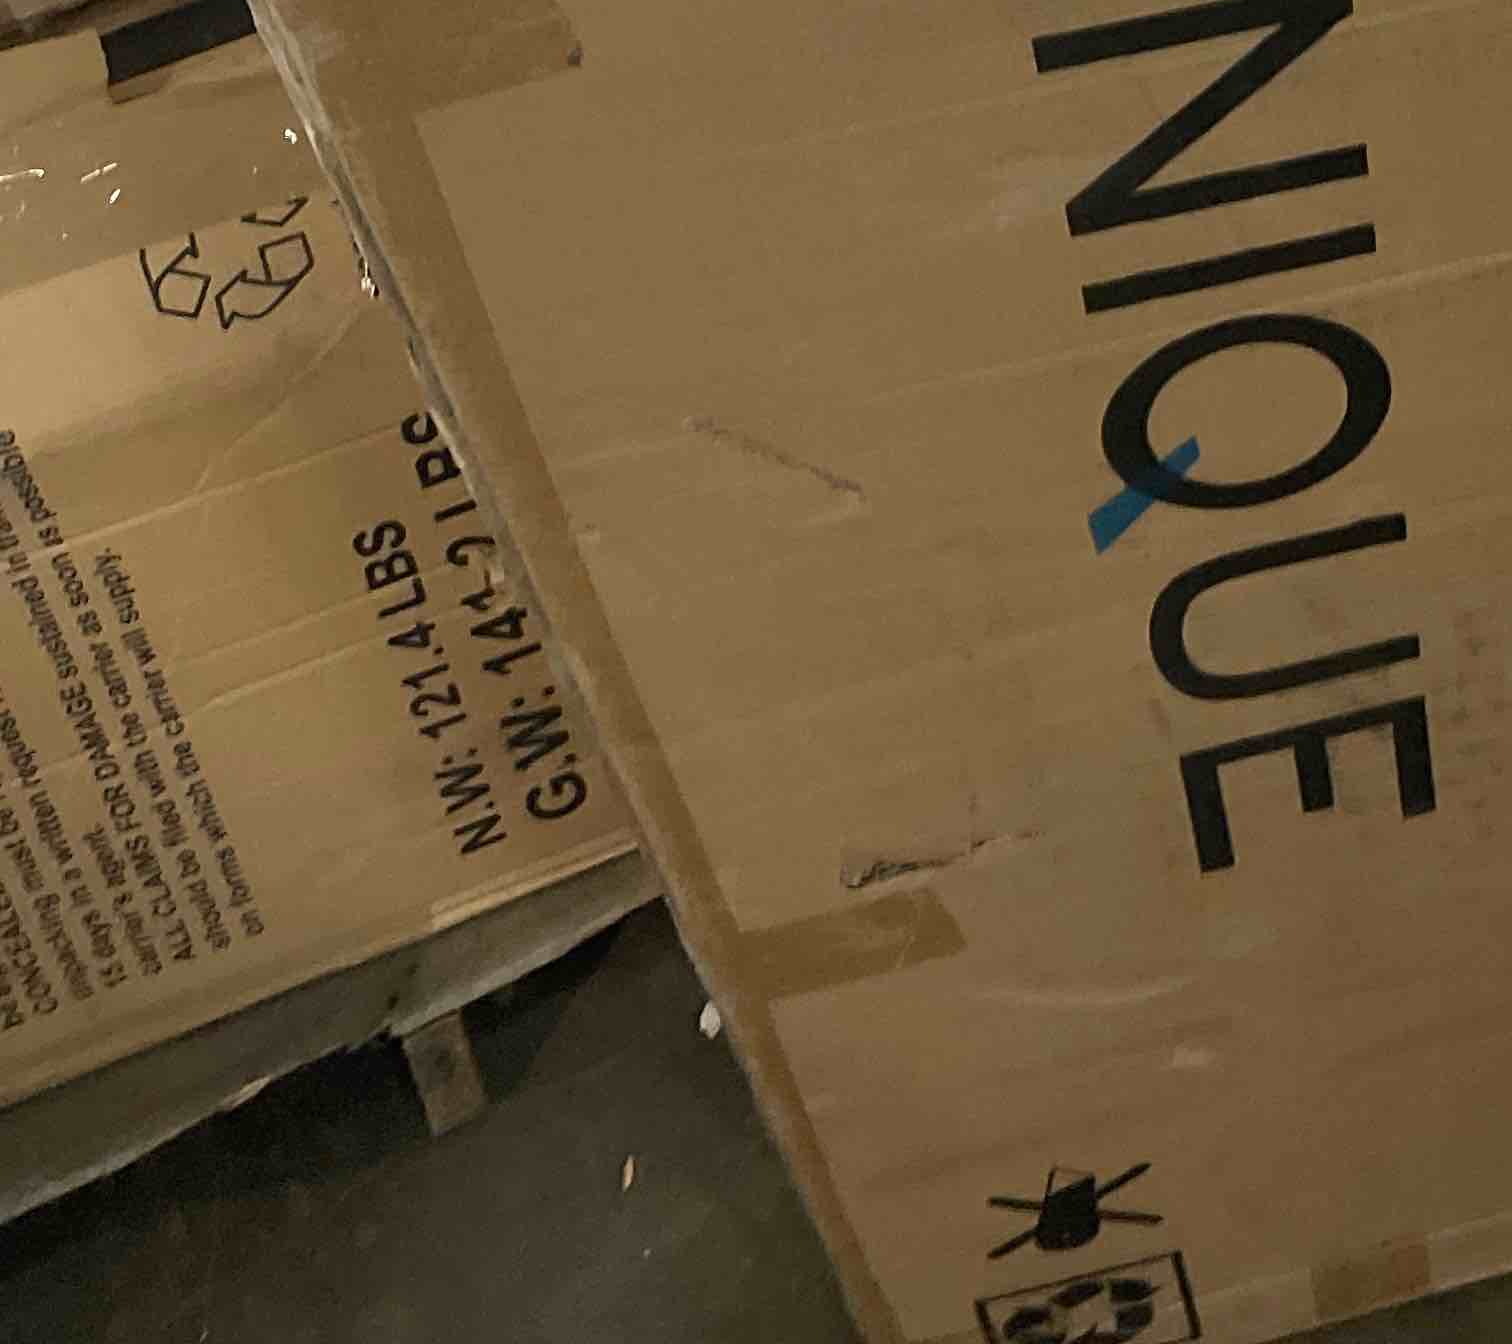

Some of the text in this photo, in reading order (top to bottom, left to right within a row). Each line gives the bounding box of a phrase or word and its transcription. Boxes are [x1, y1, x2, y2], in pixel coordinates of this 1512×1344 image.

[5, 551, 32, 575] in
[51, 551, 89, 608] soon
[94, 547, 141, 624] supply.
[11, 574, 79, 680] sustained
[77, 609, 103, 637] as
[120, 626, 157, 666] will
[90, 641, 133, 710] carrier
[143, 669, 186, 737] carrier
[352, 518, 508, 856] N.W: 121.4 LBS
[60, 682, 120, 782] DAMAGE
[120, 710, 149, 748] the
[500, 684, 588, 821] G.W:
[133, 748, 167, 798] with
[173, 740, 201, 779] the
[28, 789, 74, 865] written
[102, 782, 143, 834] FOR
[154, 798, 190, 848] filed
[185, 777, 229, 844] which
[125, 833, 177, 918] CLAIMS
[176, 847, 201, 879] be
[215, 845, 255, 908] forms
[81, 909, 118, 959] days
[164, 917, 198, 962] ALL
[186, 877, 232, 953] should
